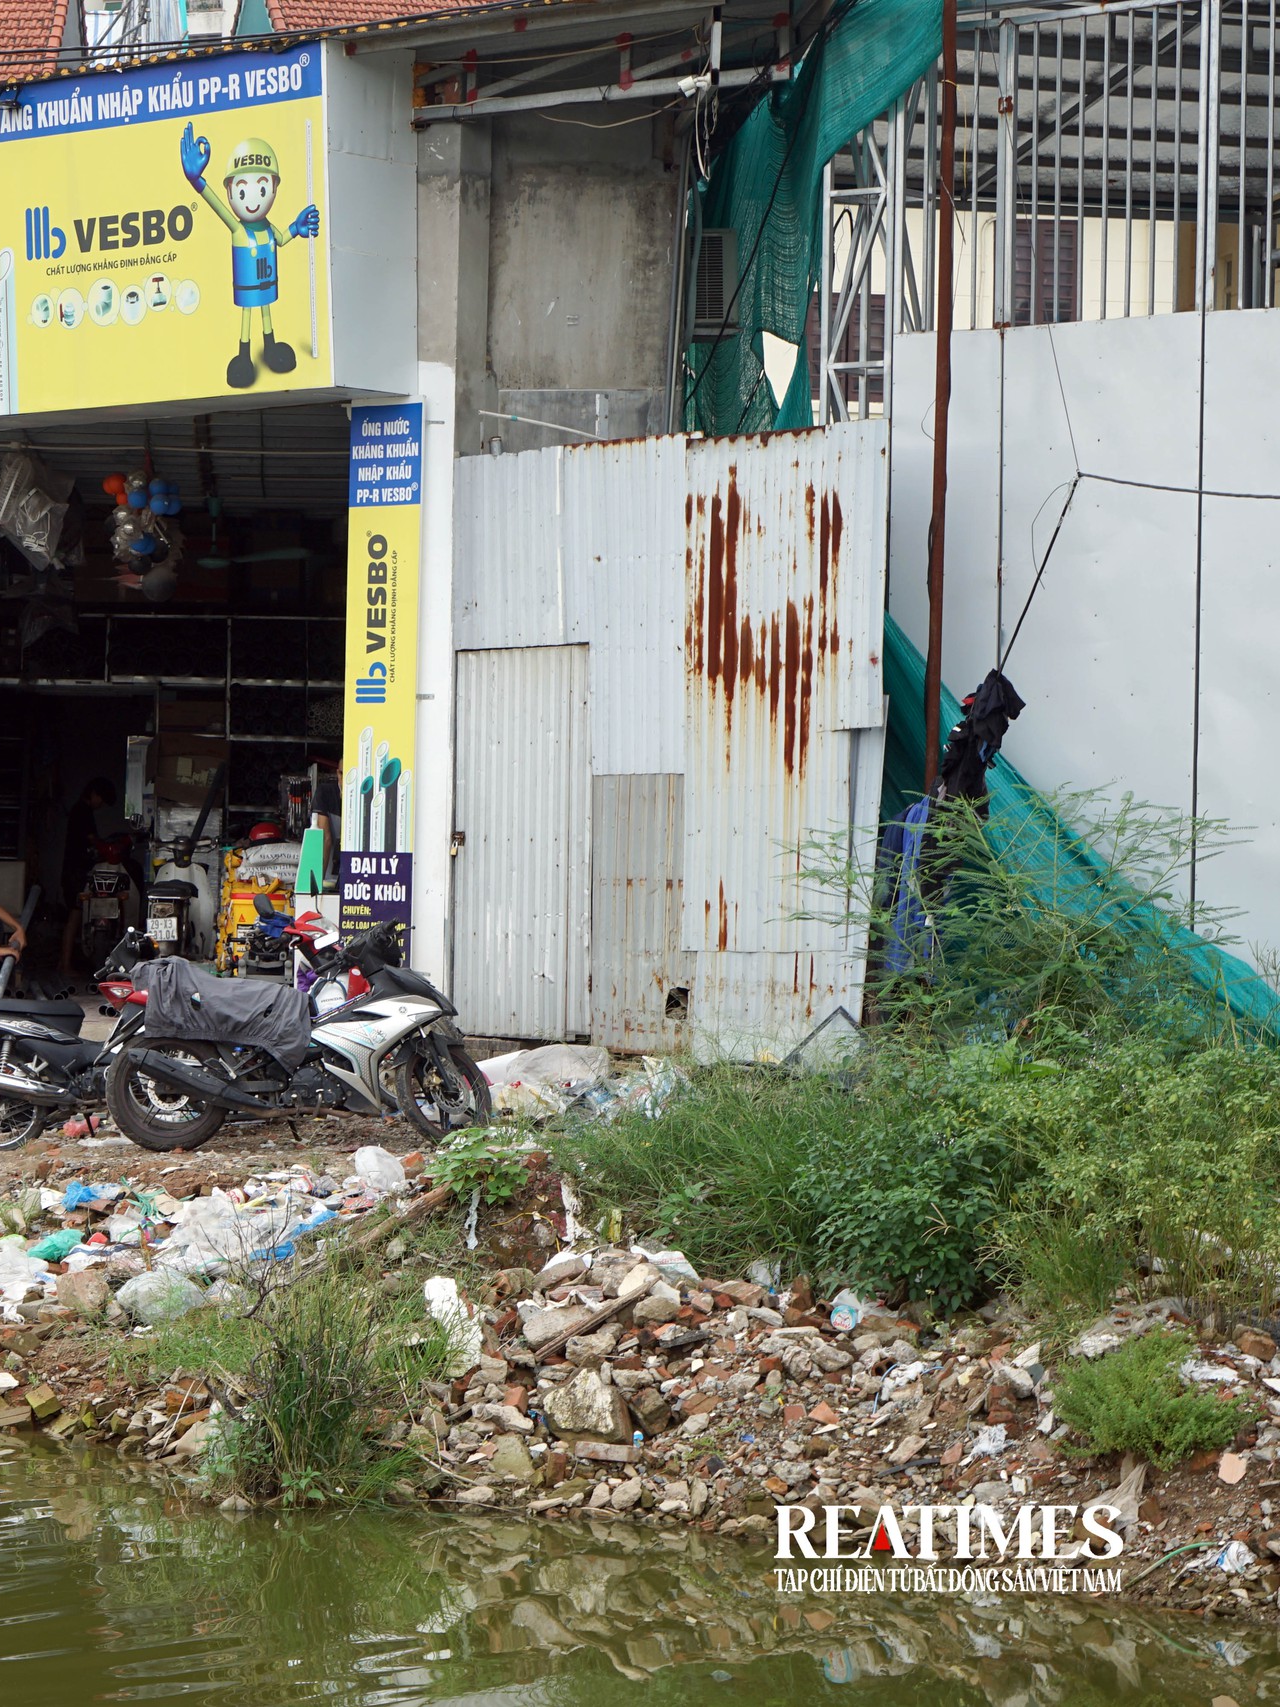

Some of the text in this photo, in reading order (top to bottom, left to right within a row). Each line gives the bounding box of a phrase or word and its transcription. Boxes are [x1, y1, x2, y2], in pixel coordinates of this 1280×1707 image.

[37, 87, 93, 128] KHUẨN
[97, 84, 143, 122] NHẬP
[148, 71, 194, 113] KHẨU
[198, 73, 241, 106] PP-R
[233, 153, 272, 169] VESBO
[361, 416, 410, 437] ỐNG NƯỚC
[352, 436, 419, 460] KHÁNG KHUẨN
[358, 459, 412, 484] NHẬP KHẨU
[356, 488, 379, 503] PP-R
[350, 854, 399, 878] ĐẠI LÝ
[344, 879, 406, 902] ĐỨC KHÔI
[342, 904, 371, 916] CHUYÊN:
[342, 920, 355, 930] CÁC
